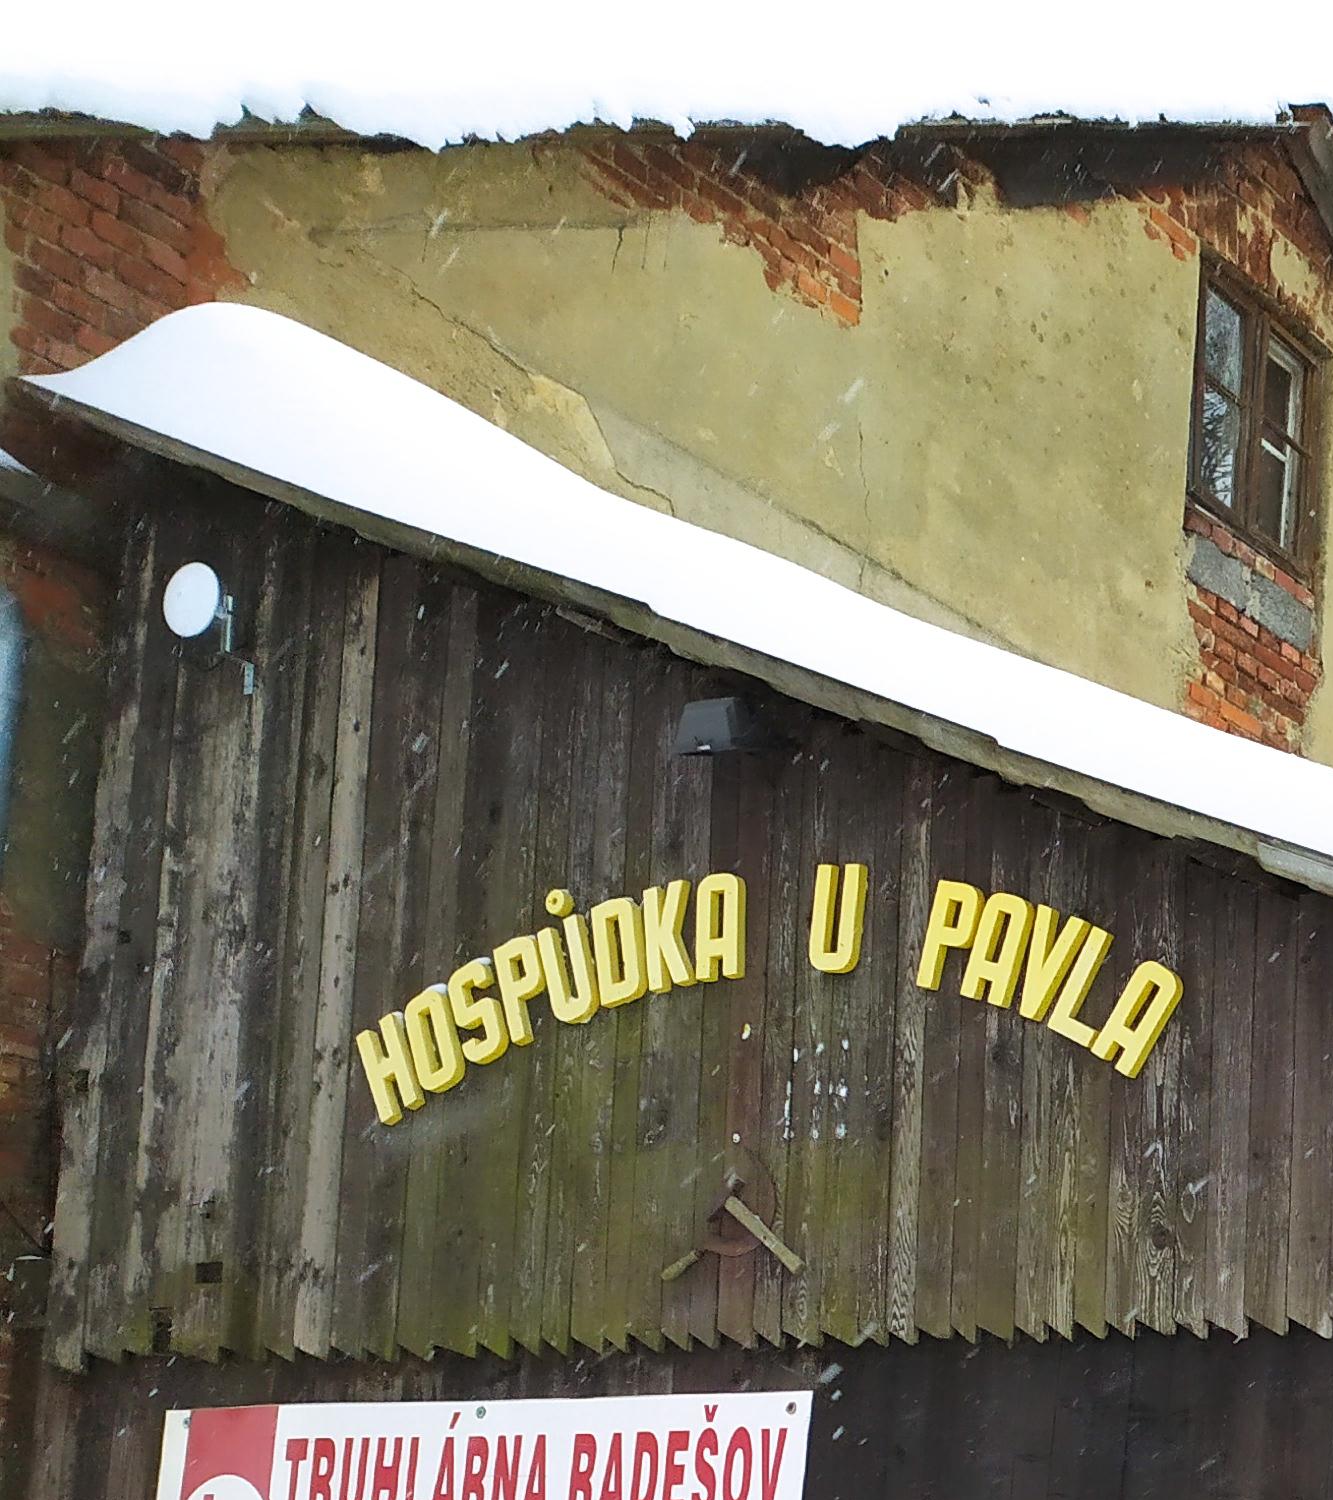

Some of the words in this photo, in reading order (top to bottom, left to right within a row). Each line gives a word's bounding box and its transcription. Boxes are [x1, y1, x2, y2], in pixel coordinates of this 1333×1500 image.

[356, 872, 746, 1126] HOSPŮDKA
[808, 863, 867, 974] U
[915, 878, 1185, 1079] PAVLA
